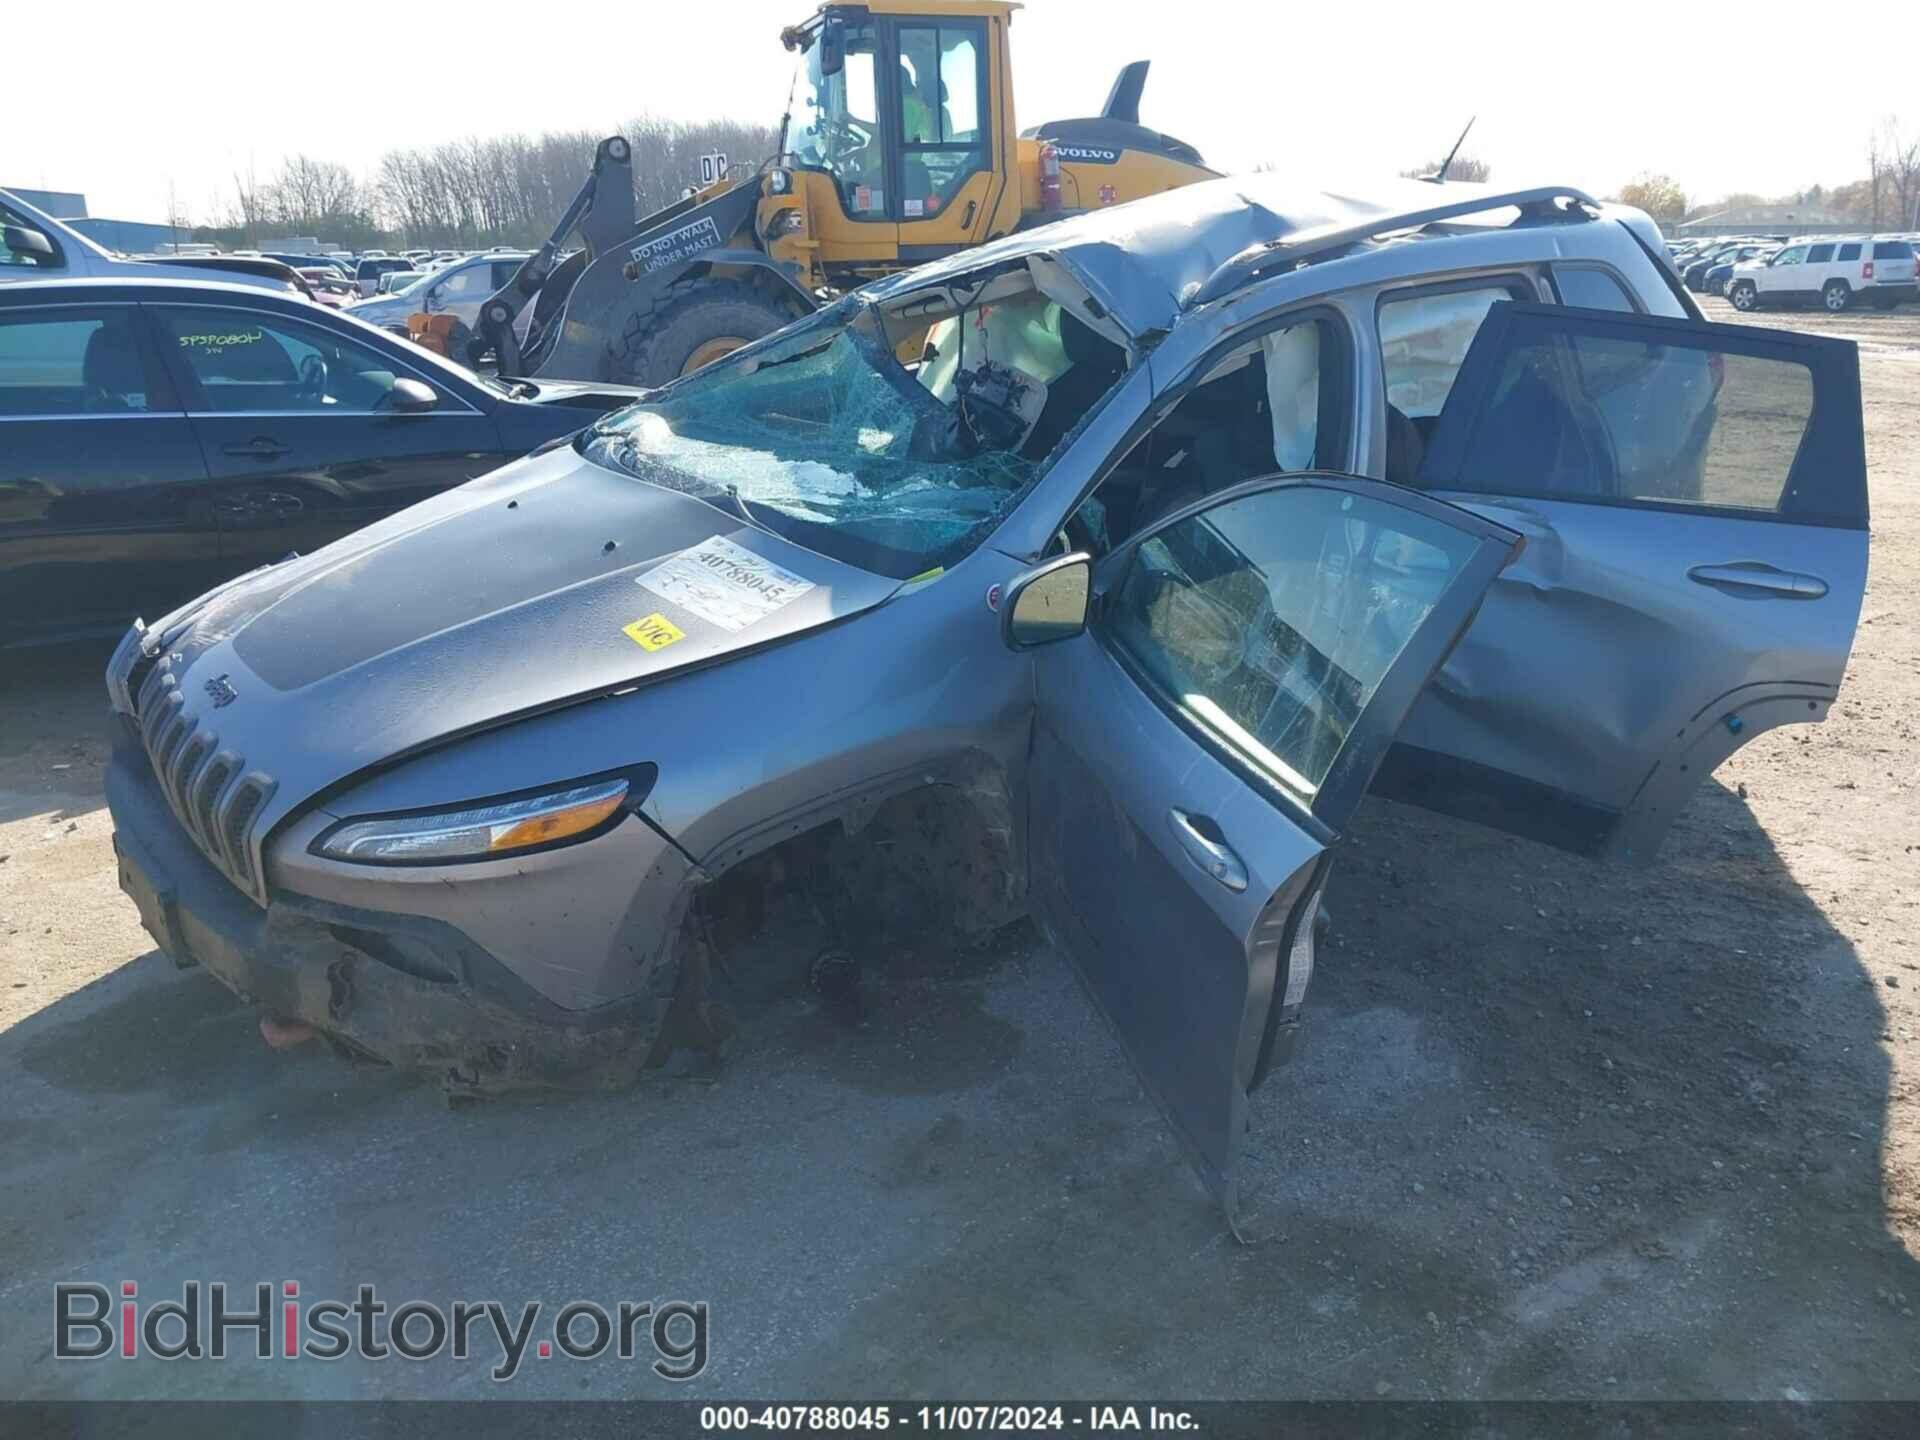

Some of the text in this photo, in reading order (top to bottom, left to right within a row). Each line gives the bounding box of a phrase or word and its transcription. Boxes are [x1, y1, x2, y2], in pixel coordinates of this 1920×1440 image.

[1057, 147, 1115, 159] VOLVO
[632, 221, 713, 262] DO NOT WALK
[644, 235, 713, 272] UNDER MAST
[699, 551, 786, 602] 40788045
[636, 618, 673, 645] VIC
